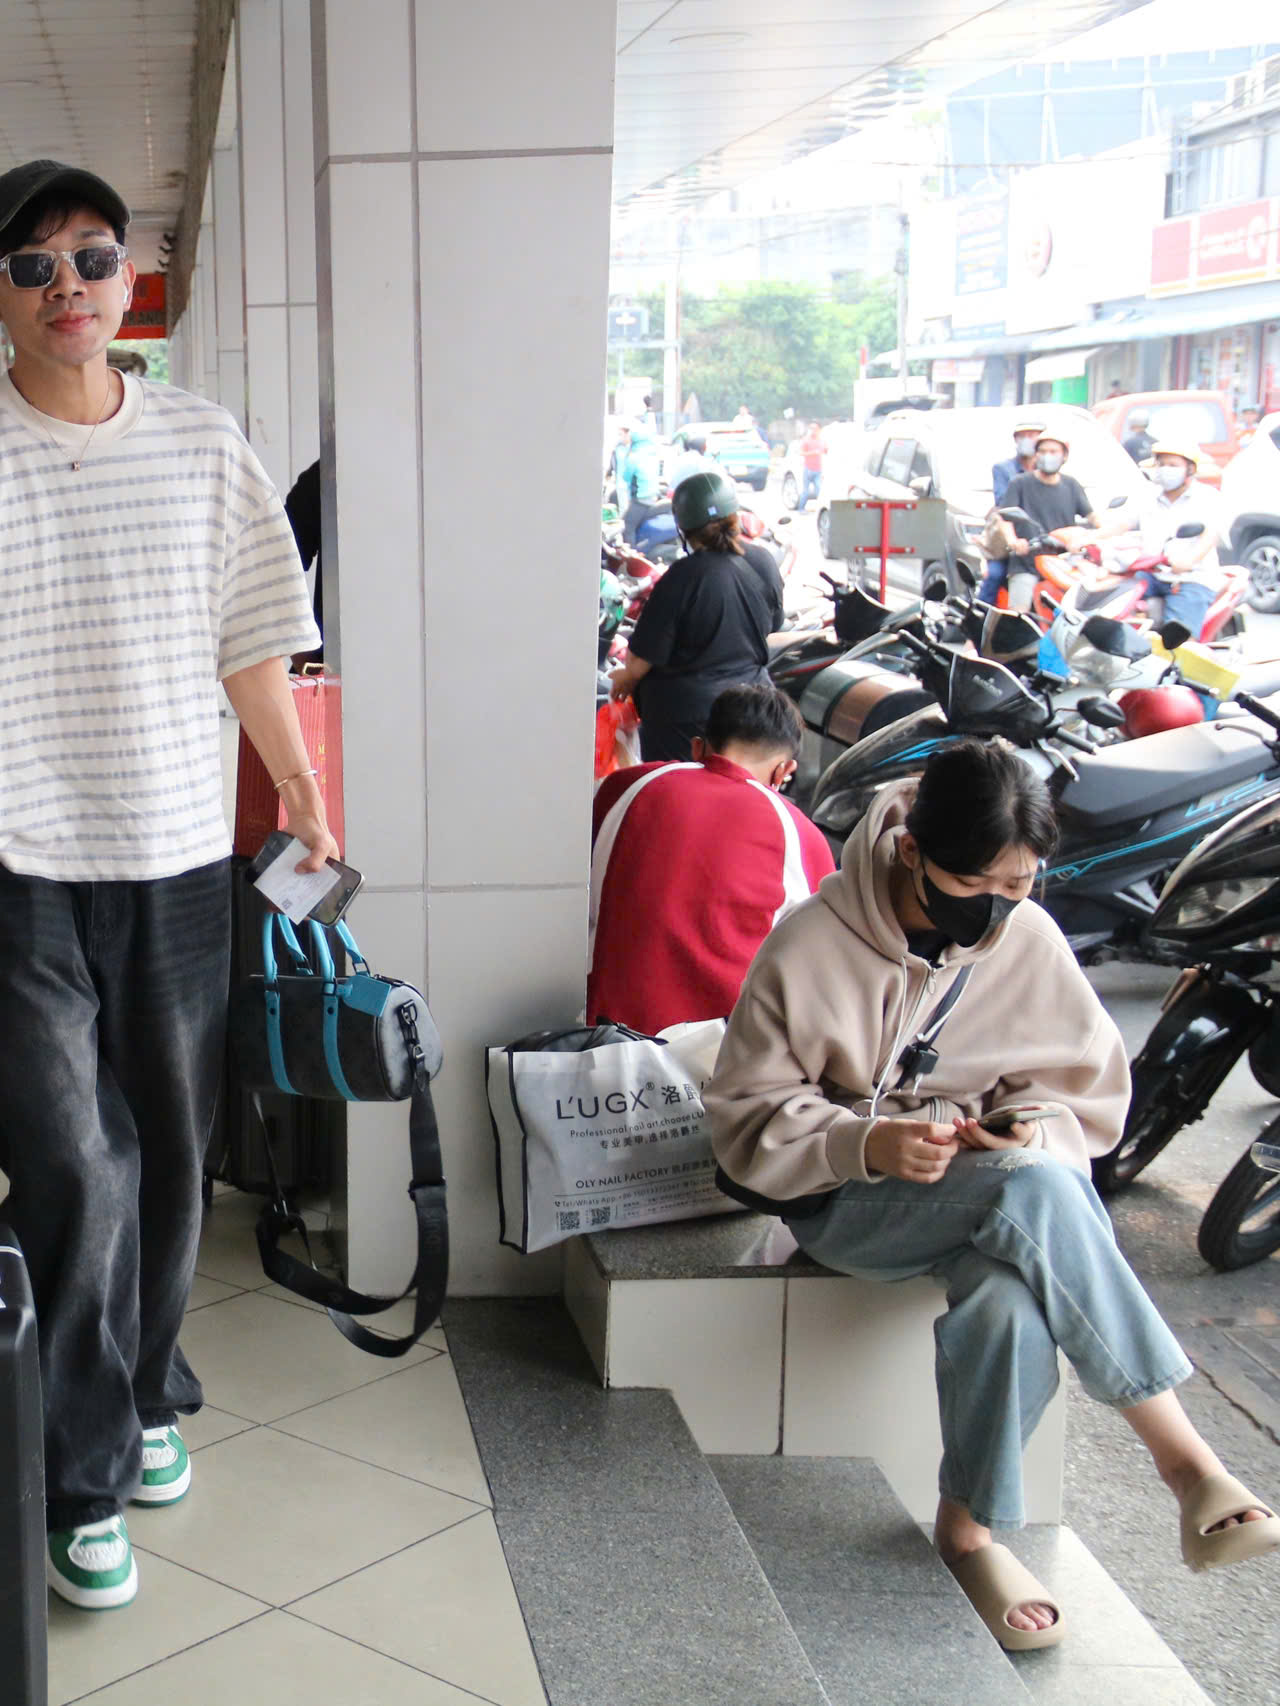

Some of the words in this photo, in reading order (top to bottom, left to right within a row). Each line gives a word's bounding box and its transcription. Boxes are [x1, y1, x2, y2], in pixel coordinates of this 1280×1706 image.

[570, 1125, 627, 1138] Professional
[629, 1123, 645, 1133] nail
[575, 1180, 595, 1189] OLY
[599, 1176, 622, 1187] NAIL
[624, 1167, 669, 1183] FACTORY
